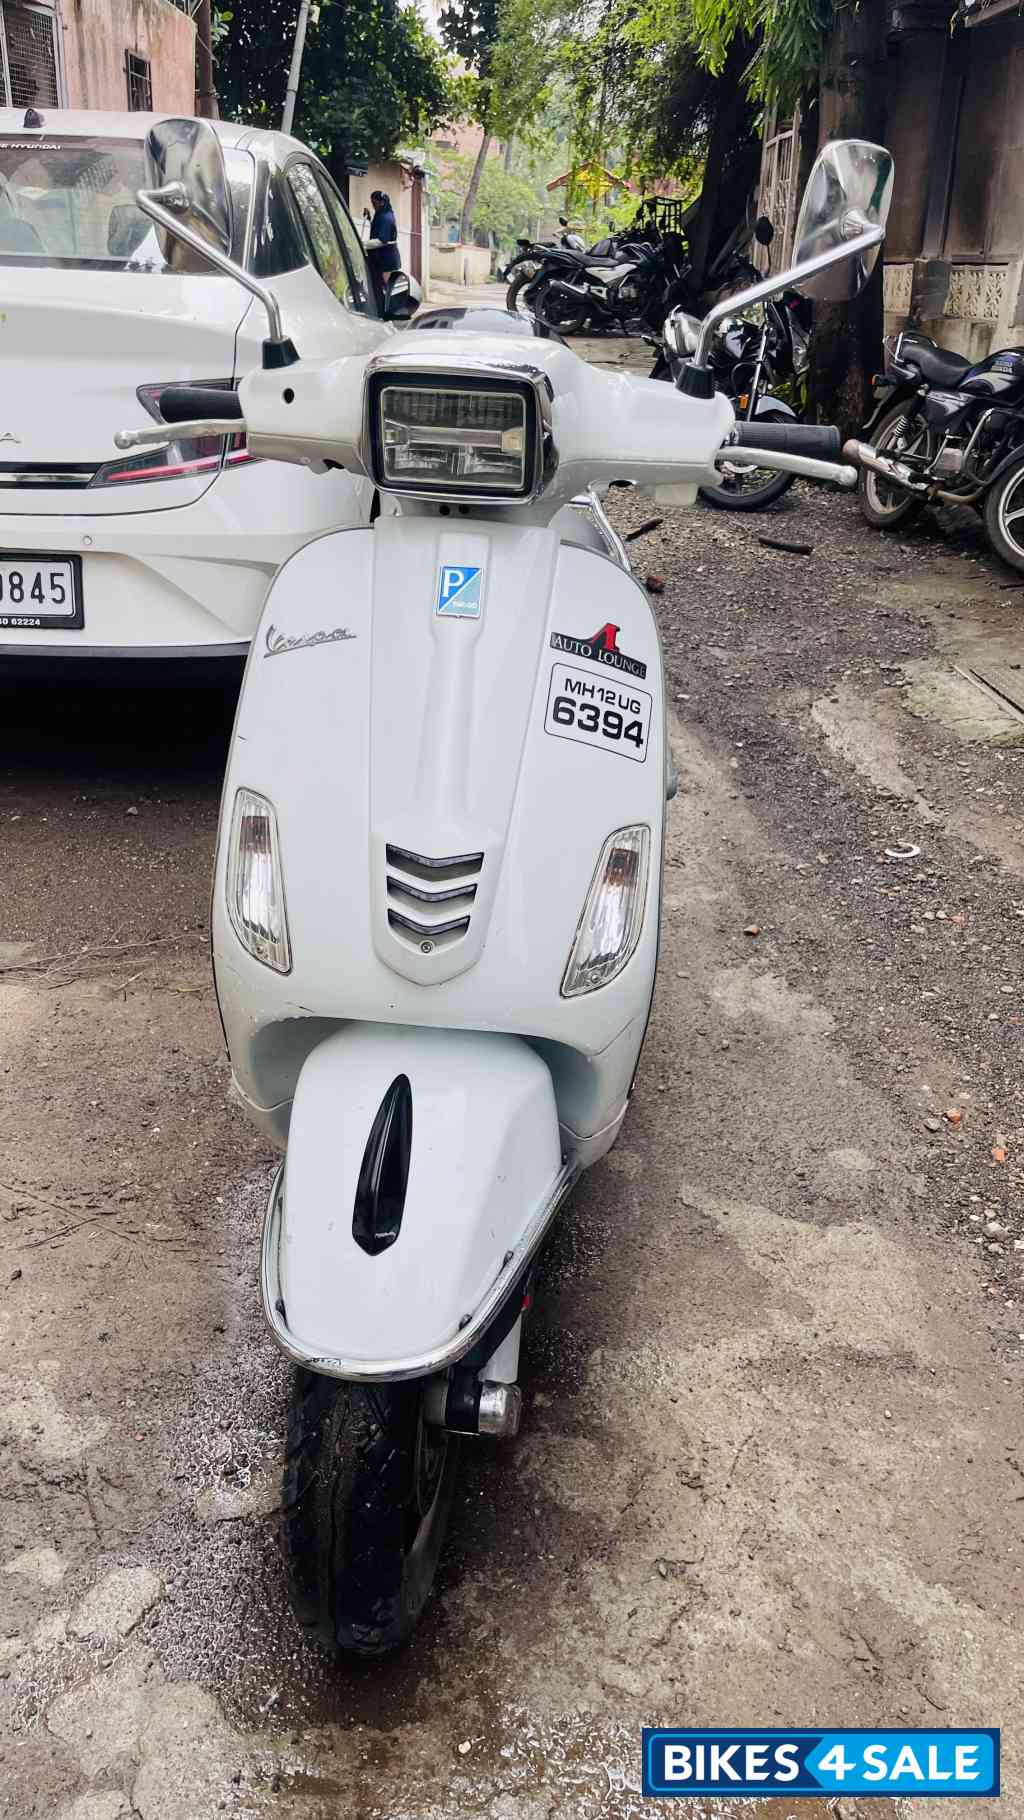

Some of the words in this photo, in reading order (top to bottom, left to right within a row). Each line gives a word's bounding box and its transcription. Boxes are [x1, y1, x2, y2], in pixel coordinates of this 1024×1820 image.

[0, 571, 66, 604] 845
[553, 635, 592, 657] AUTO
[597, 648, 647, 679] LOUNGE
[552, 696, 644, 748] 6394
